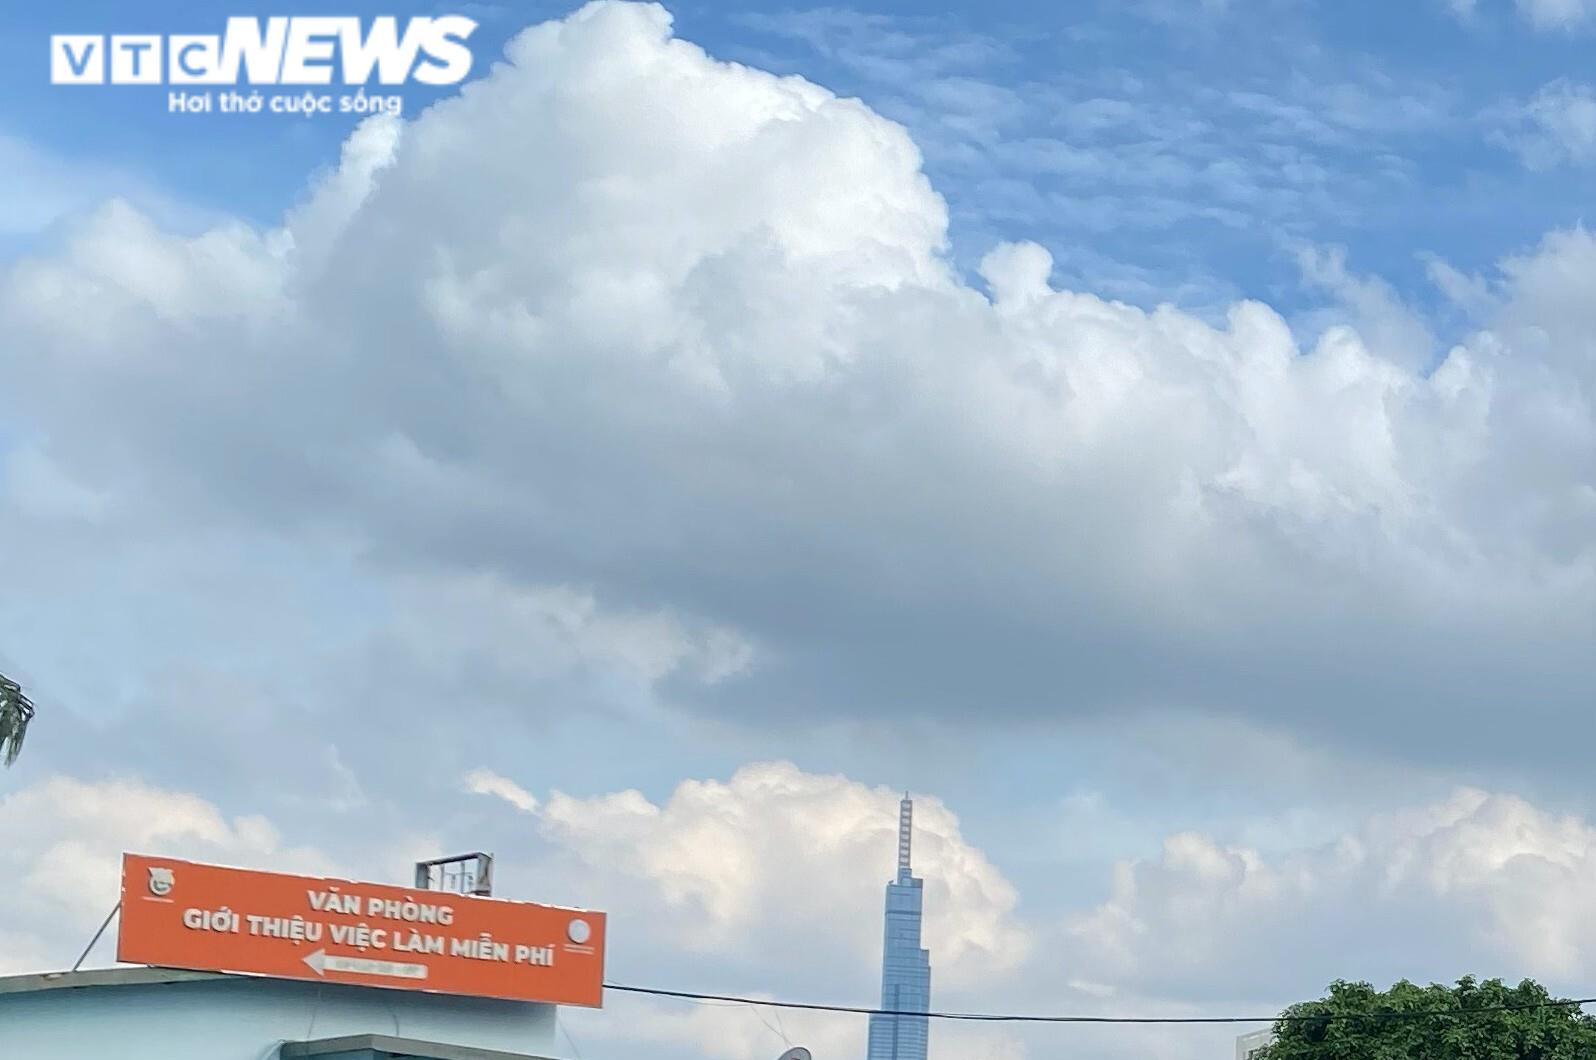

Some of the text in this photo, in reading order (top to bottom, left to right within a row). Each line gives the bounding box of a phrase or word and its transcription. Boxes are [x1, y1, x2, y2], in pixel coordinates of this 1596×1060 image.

[307, 886, 454, 925] VĂN PHÒNG
[183, 906, 556, 967] GIỚI THIỆU VIỆC LÀM MIỄN PHÍ
